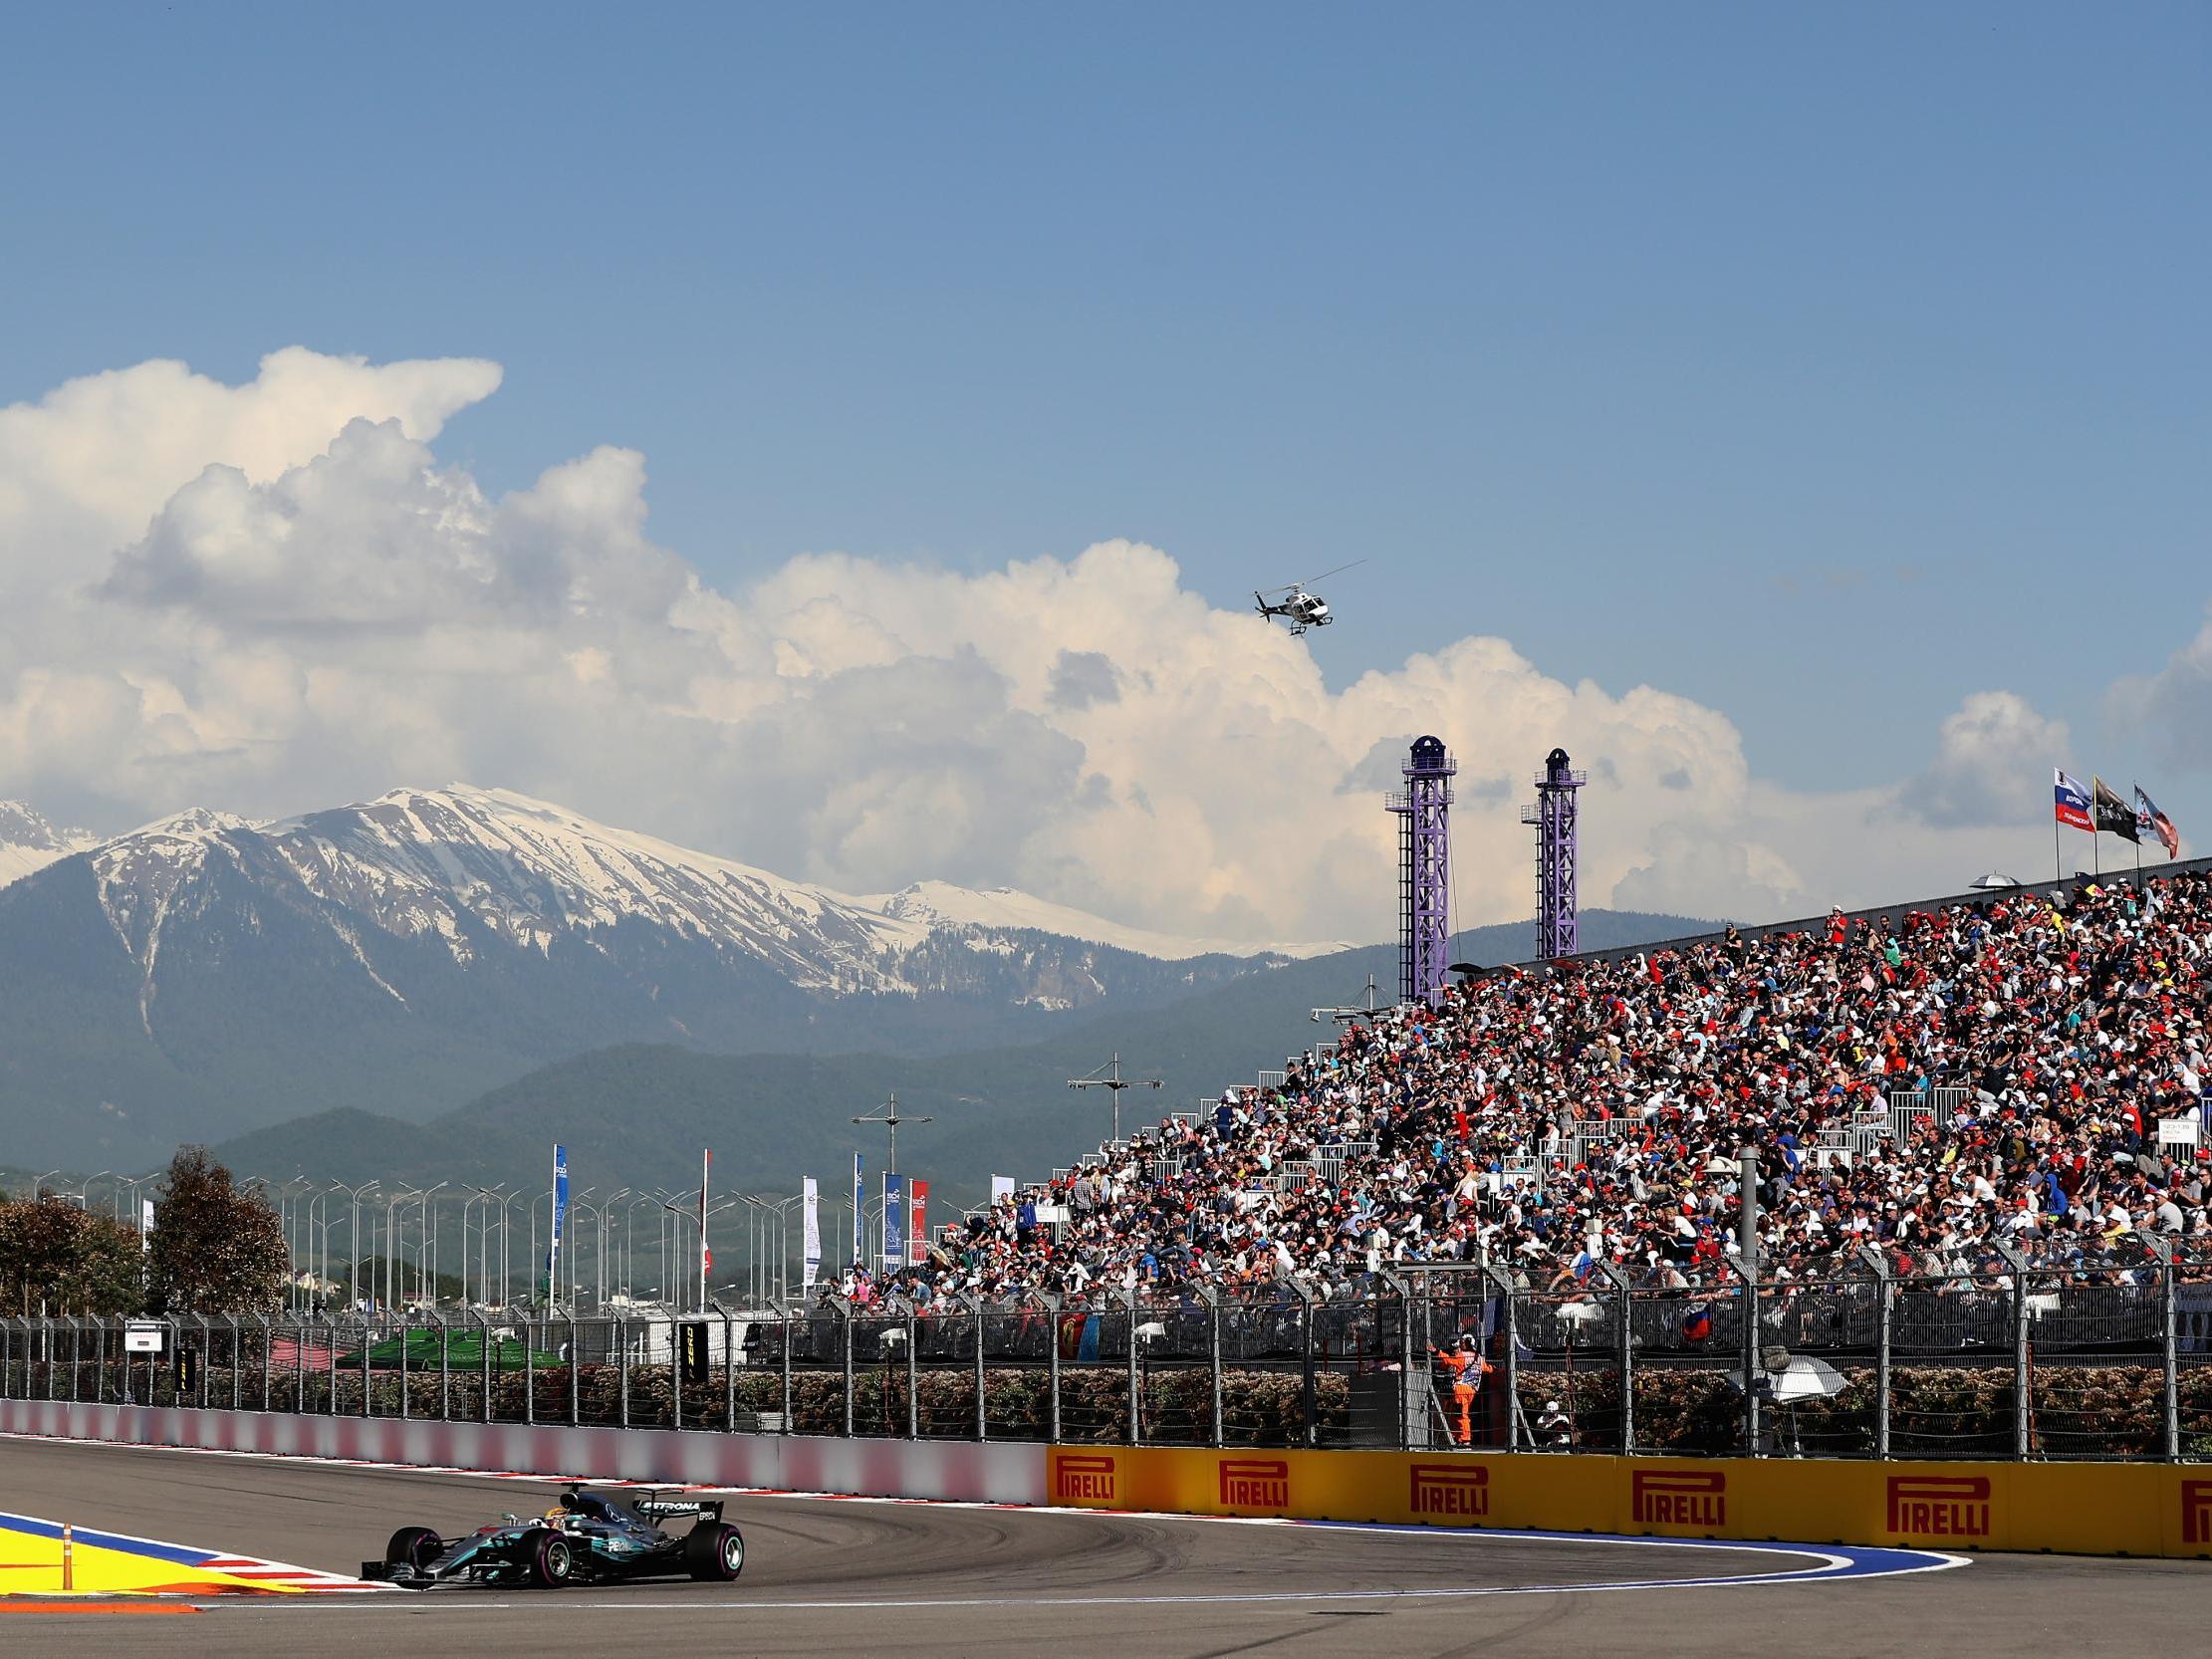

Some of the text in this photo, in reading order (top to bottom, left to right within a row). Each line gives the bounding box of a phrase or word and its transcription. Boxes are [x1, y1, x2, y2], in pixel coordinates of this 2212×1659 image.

[1056, 1455, 1114, 1500] PIRELLI
[1219, 1460, 1289, 1508] PIRELLI
[1410, 1465, 1489, 1516] PIRELLI
[1632, 1470, 1726, 1526] PIRELLI
[1887, 1476, 1991, 1536] PIRELLI
